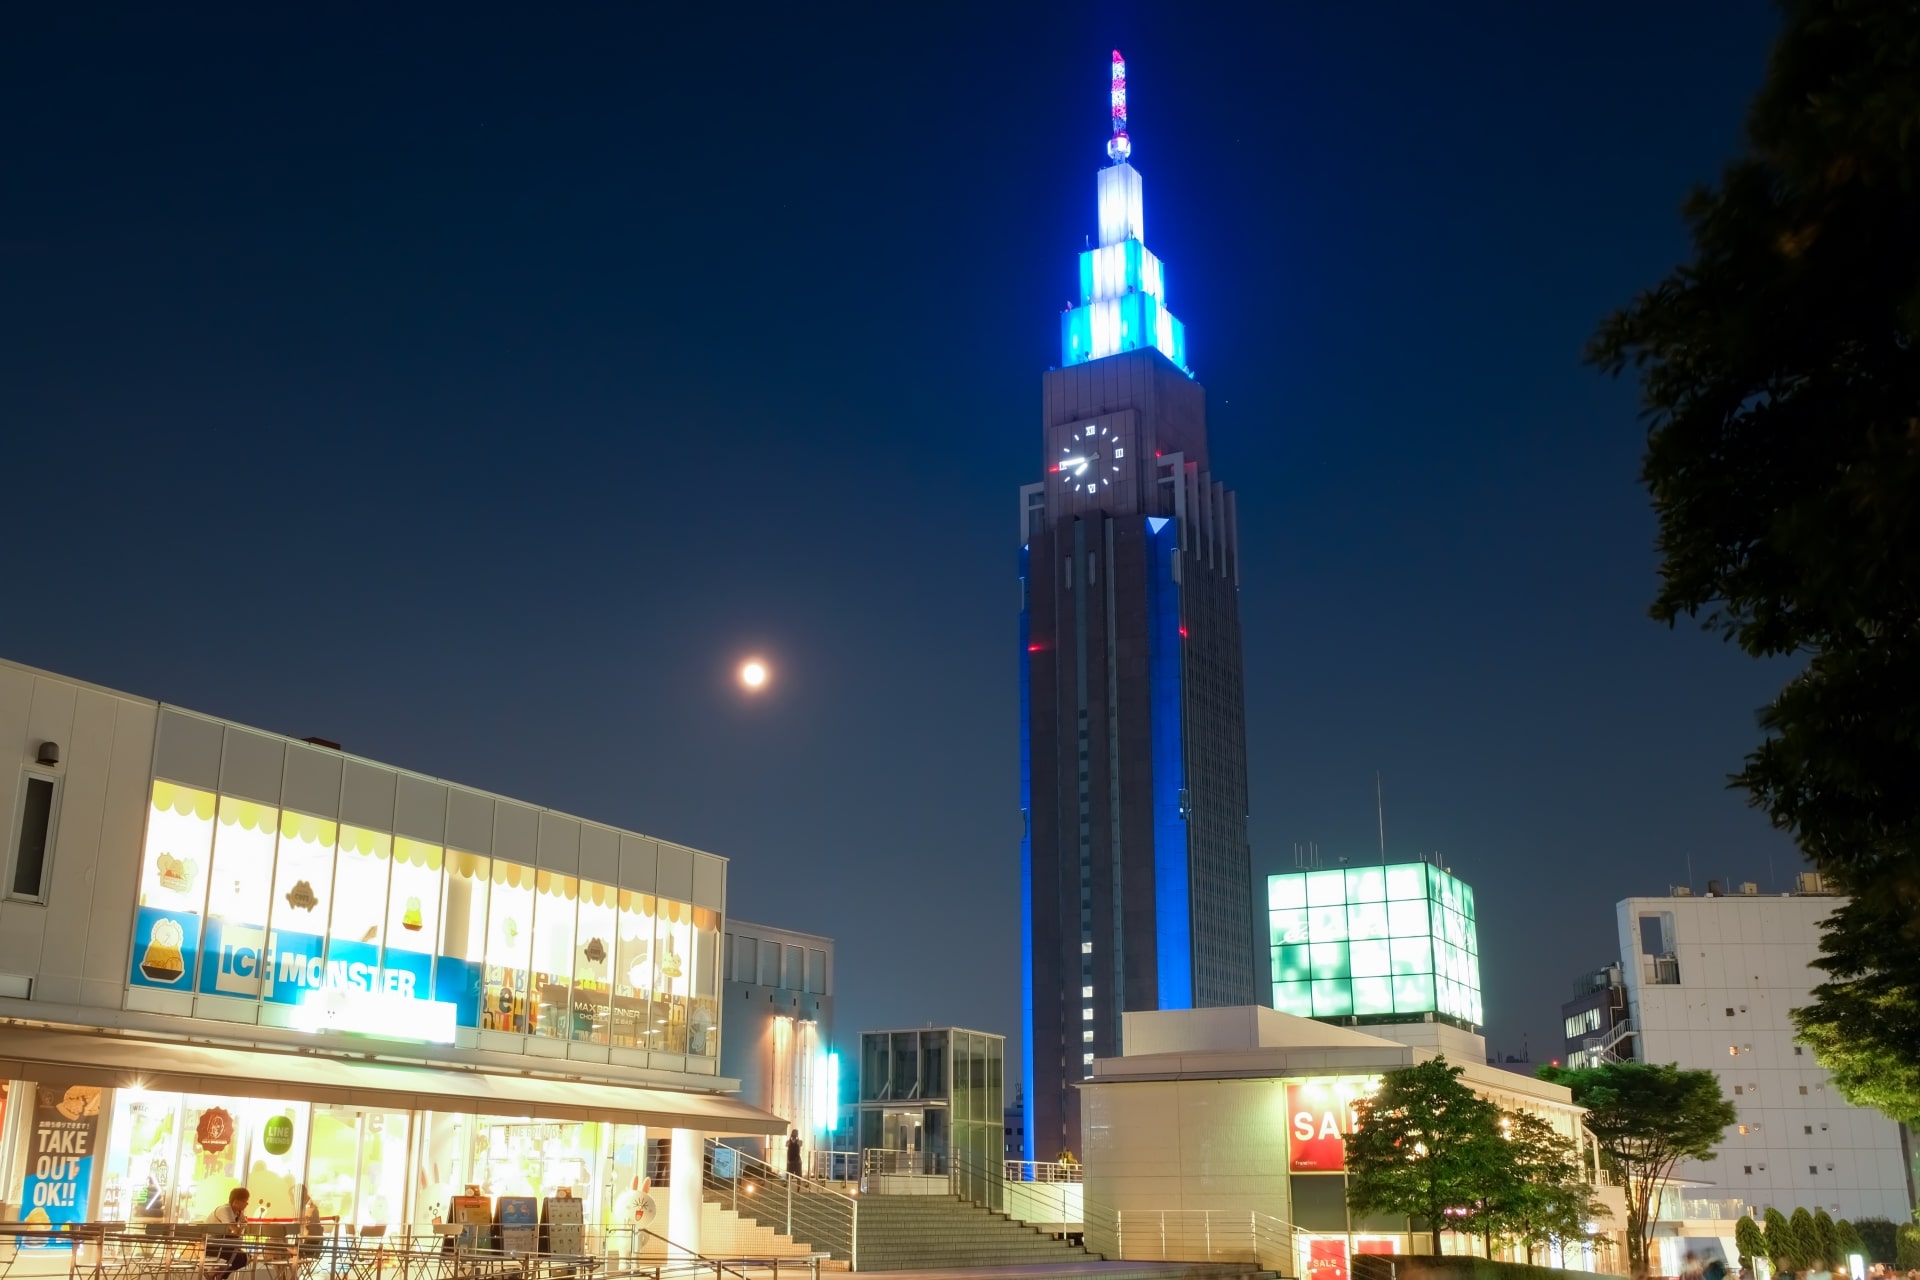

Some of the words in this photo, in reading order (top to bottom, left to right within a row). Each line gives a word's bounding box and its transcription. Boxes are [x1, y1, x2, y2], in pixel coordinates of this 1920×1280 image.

[222, 944, 271, 981] ICE
[279, 952, 416, 998] MONSTER
[574, 1001, 596, 1012] MAX
[579, 1013, 618, 1025] CHOCOLAE
[268, 1126, 290, 1137] LINE
[37, 1129, 88, 1154] TAKE
[265, 1137, 290, 1145] FRIENDS
[36, 1155, 80, 1180] OUT
[33, 1182, 77, 1207] OK!!
[1313, 1259, 1337, 1267] SALE
